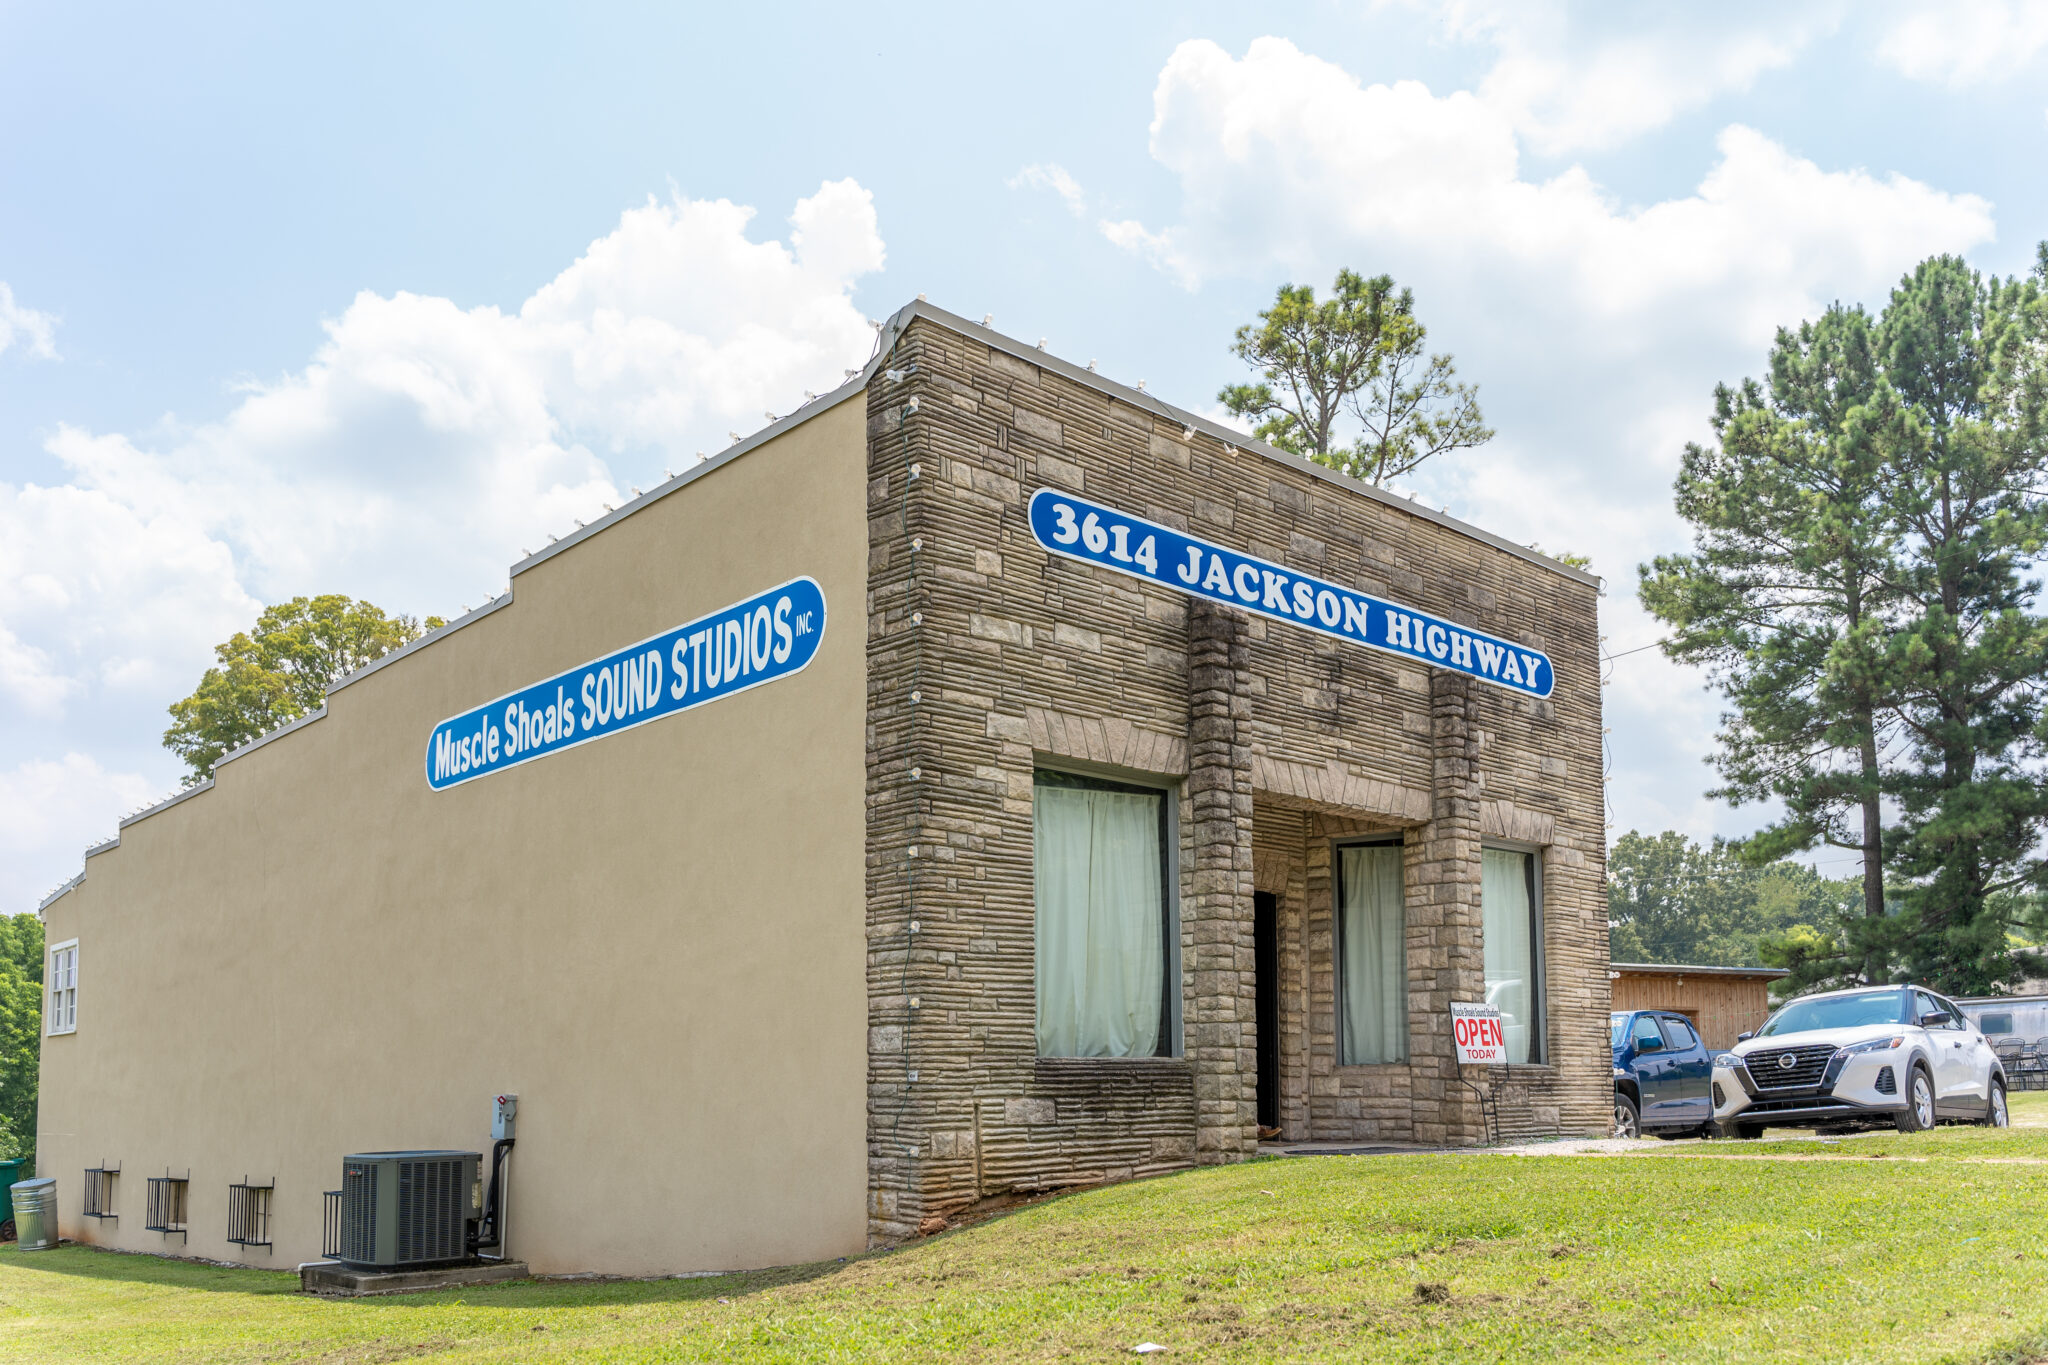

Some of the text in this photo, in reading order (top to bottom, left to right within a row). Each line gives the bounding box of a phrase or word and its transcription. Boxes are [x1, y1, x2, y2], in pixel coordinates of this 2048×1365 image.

[1052, 503, 1542, 688] 3614 JACKSON HIGHWAY
[435, 596, 814, 781] Muscle Shoals SOUND STUDIOS INC.
[1455, 1018, 1503, 1046] OPEN
[1466, 1049, 1496, 1059] TODAY
